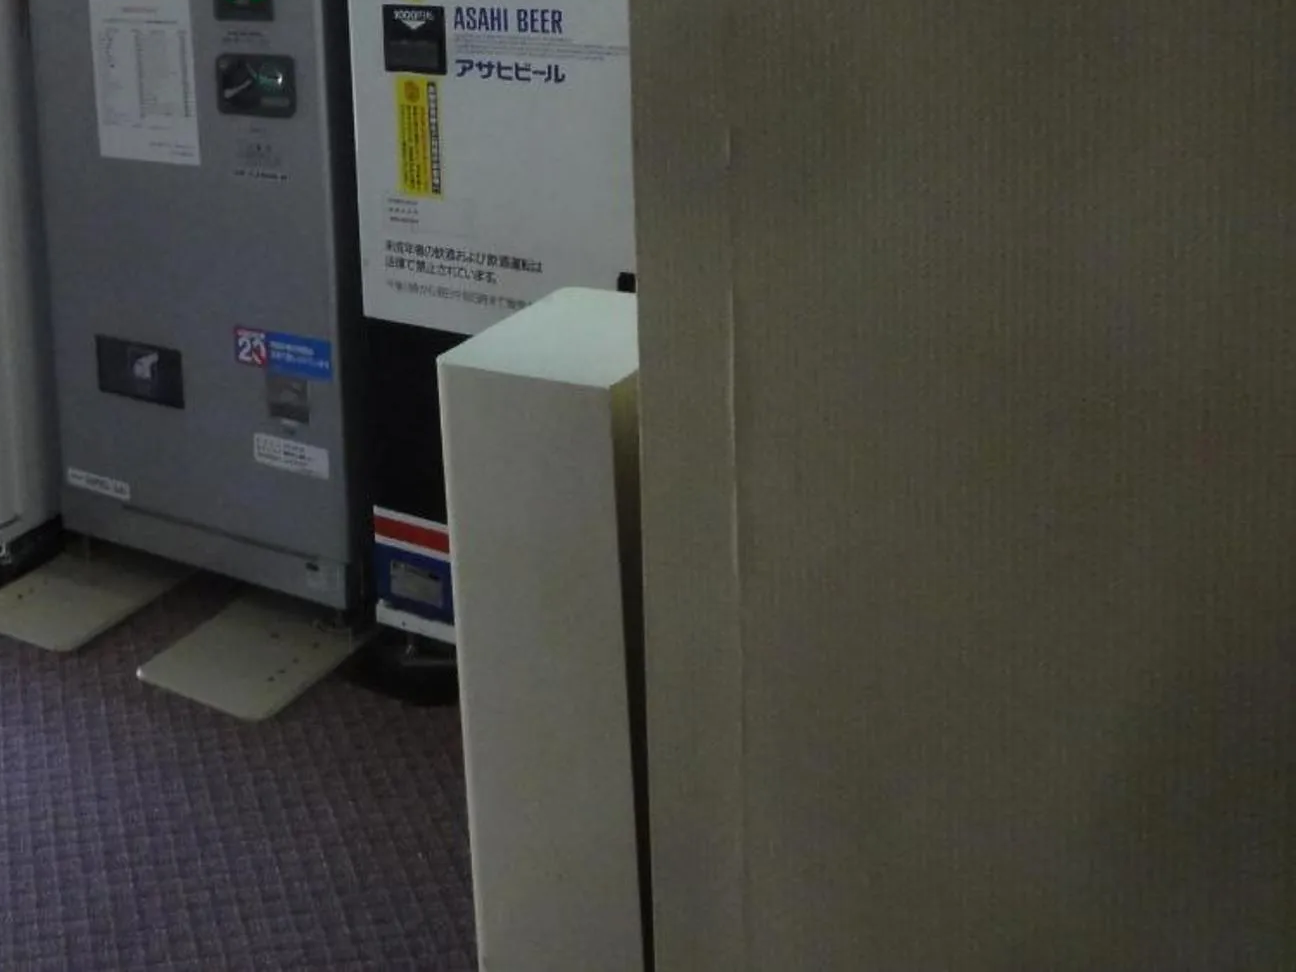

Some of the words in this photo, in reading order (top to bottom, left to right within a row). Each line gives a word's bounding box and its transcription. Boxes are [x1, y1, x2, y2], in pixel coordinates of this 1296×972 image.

[455, 6, 508, 32] ASAHI
[517, 8, 563, 34] BEER
[455, 59, 566, 83] アサヒビール
